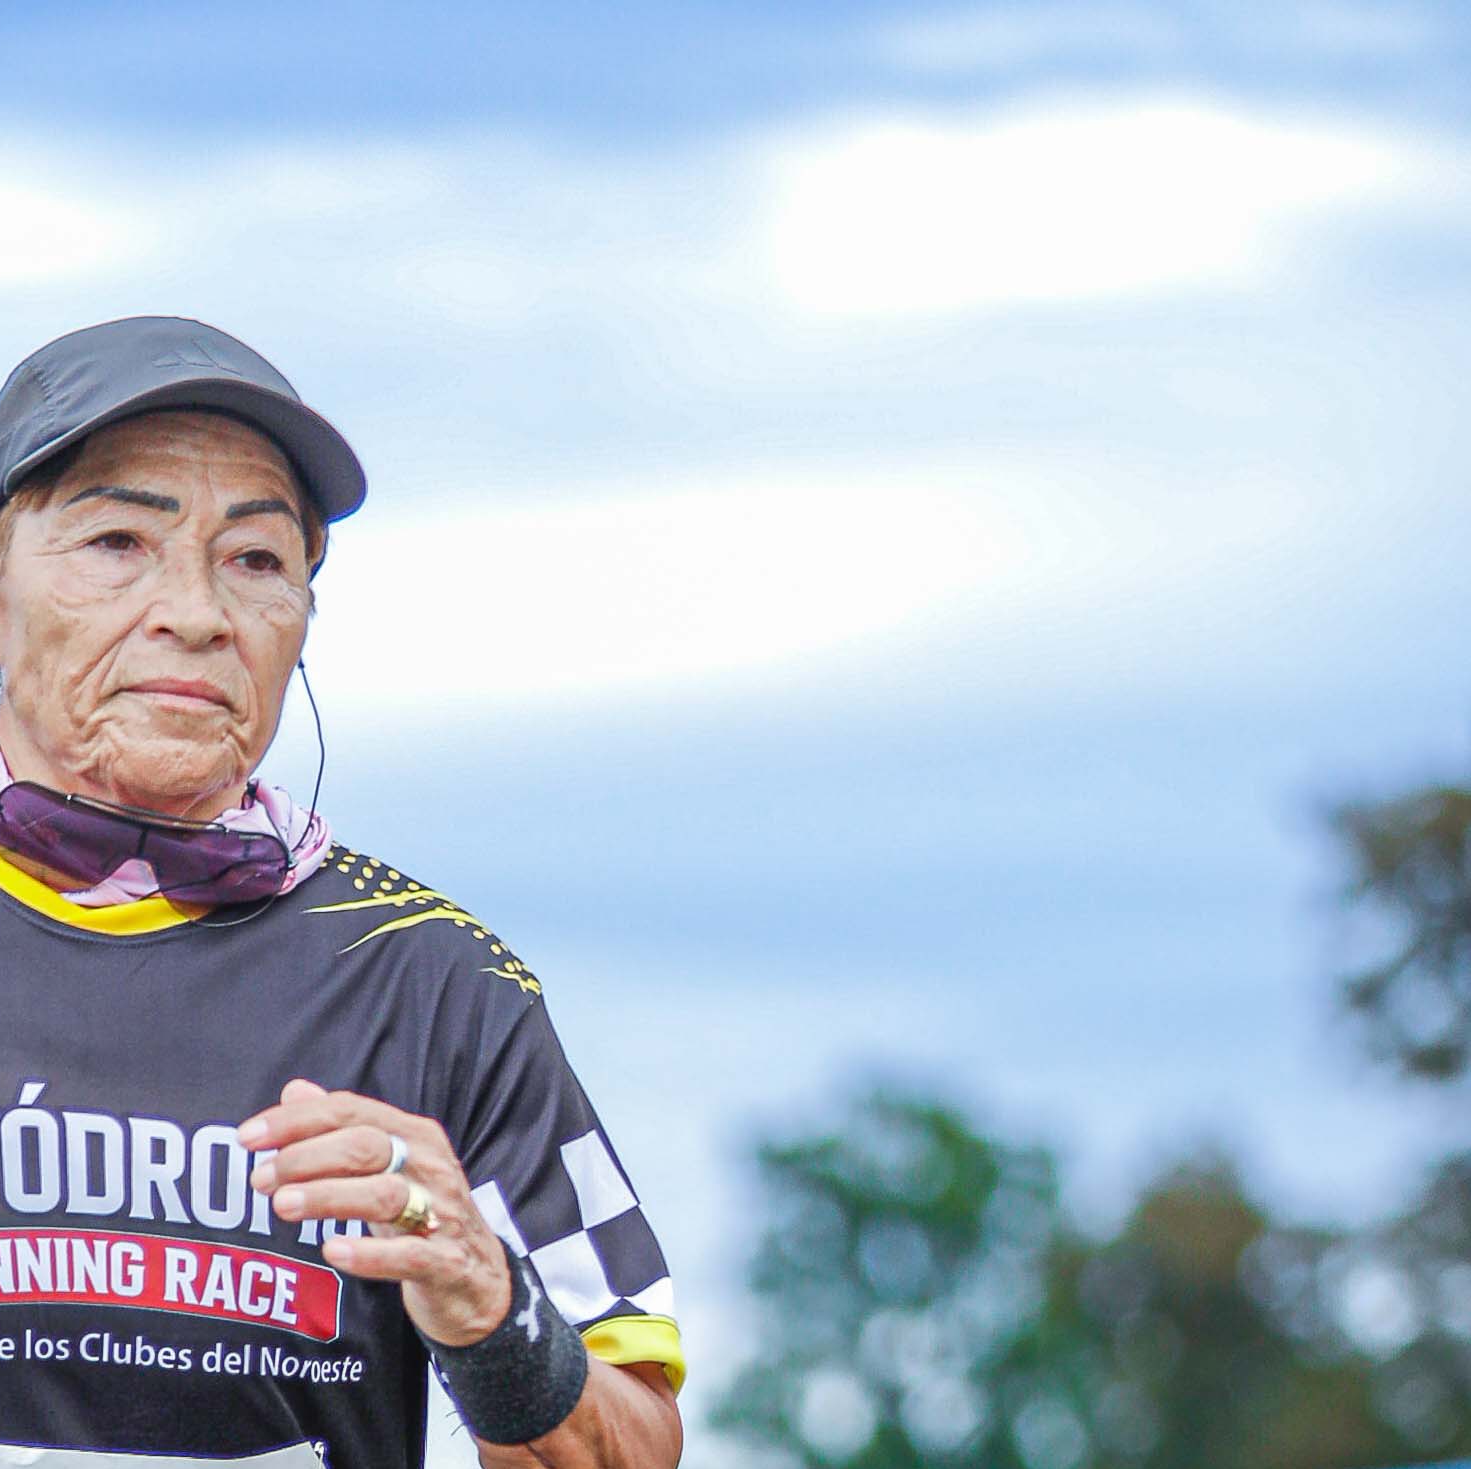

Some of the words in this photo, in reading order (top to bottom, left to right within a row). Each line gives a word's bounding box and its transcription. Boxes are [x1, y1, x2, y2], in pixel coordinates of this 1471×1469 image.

[163, 1247, 300, 1325] RACE
[25, 1329, 71, 1361] los
[79, 1334, 192, 1371] Clubes
[201, 1343, 251, 1375] del
[259, 1346, 364, 1384] Noroeste
